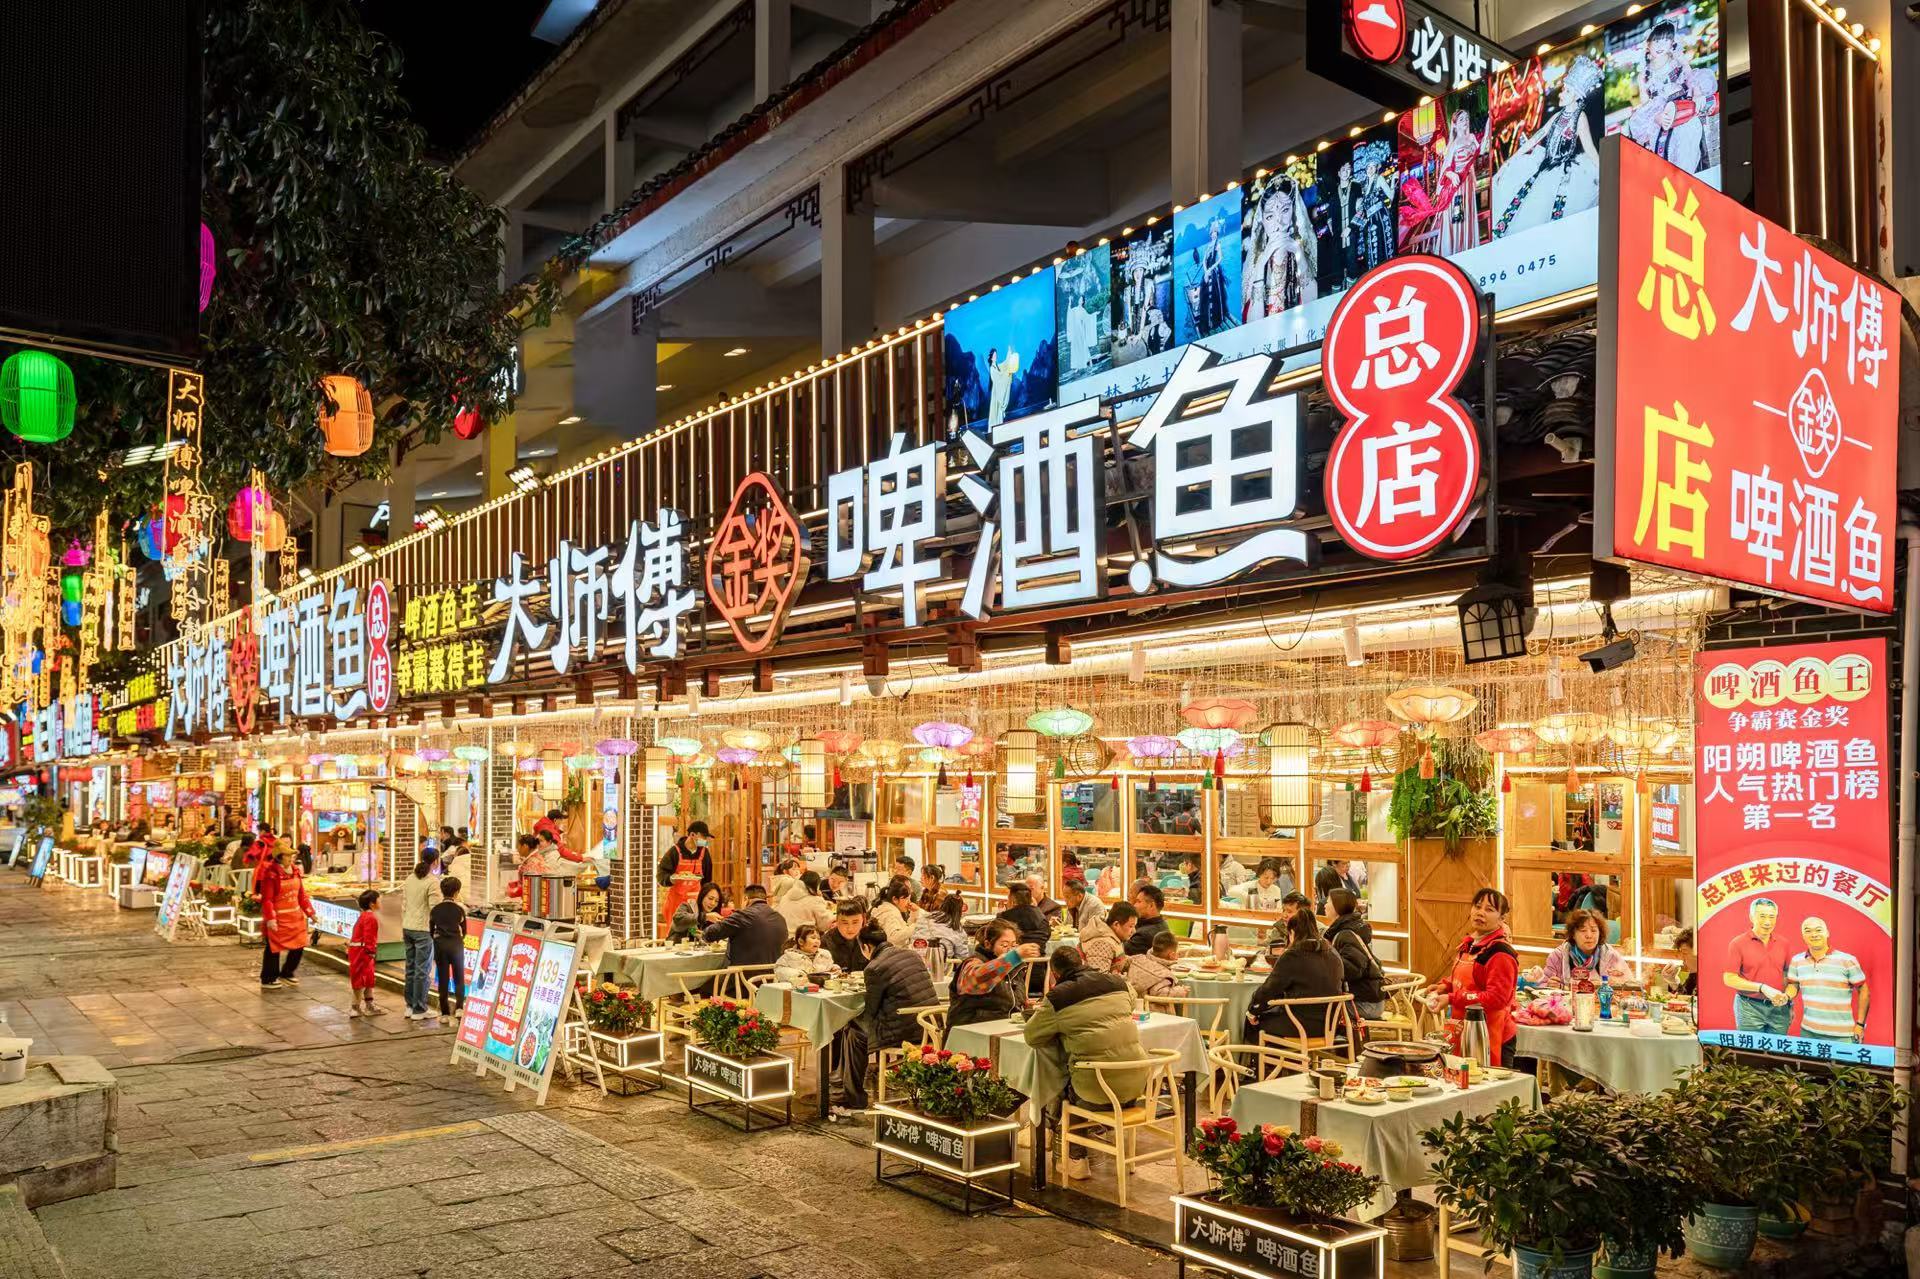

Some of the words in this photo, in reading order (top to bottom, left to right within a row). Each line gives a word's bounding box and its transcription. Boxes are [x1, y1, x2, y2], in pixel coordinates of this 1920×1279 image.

[1412, 16, 1510, 90] 必胜
[1517, 254, 1556, 275] 0475
[1730, 221, 1887, 389] 大师傅
[1634, 177, 1716, 560] 总店
[487, 508, 696, 684] 大师傅
[828, 343, 1308, 627] 啤酒鱼
[1352, 286, 1443, 529] 总店
[1731, 464, 1882, 602] 啤酒鱼
[405, 583, 477, 641] 啤酒鱼王
[164, 626, 228, 741] 大师傅
[260, 576, 367, 726] 啤酒鱼
[371, 594, 386, 701] 总店
[397, 640, 485, 697] 争霸赛得主
[1711, 662, 1871, 699] 啤酒鱼王
[1728, 706, 1850, 733] 争霸赛金奖
[1704, 737, 1878, 775] 阳朔啤酒鱼
[1704, 769, 1880, 804] 人气热门榜
[1743, 803, 1836, 830] 第一名
[1701, 862, 1890, 910] 总理来过的餐厅
[1720, 1033, 1872, 1065] 阳朔必吃菜第一名
[1191, 1216, 1247, 1253] 大师傅
